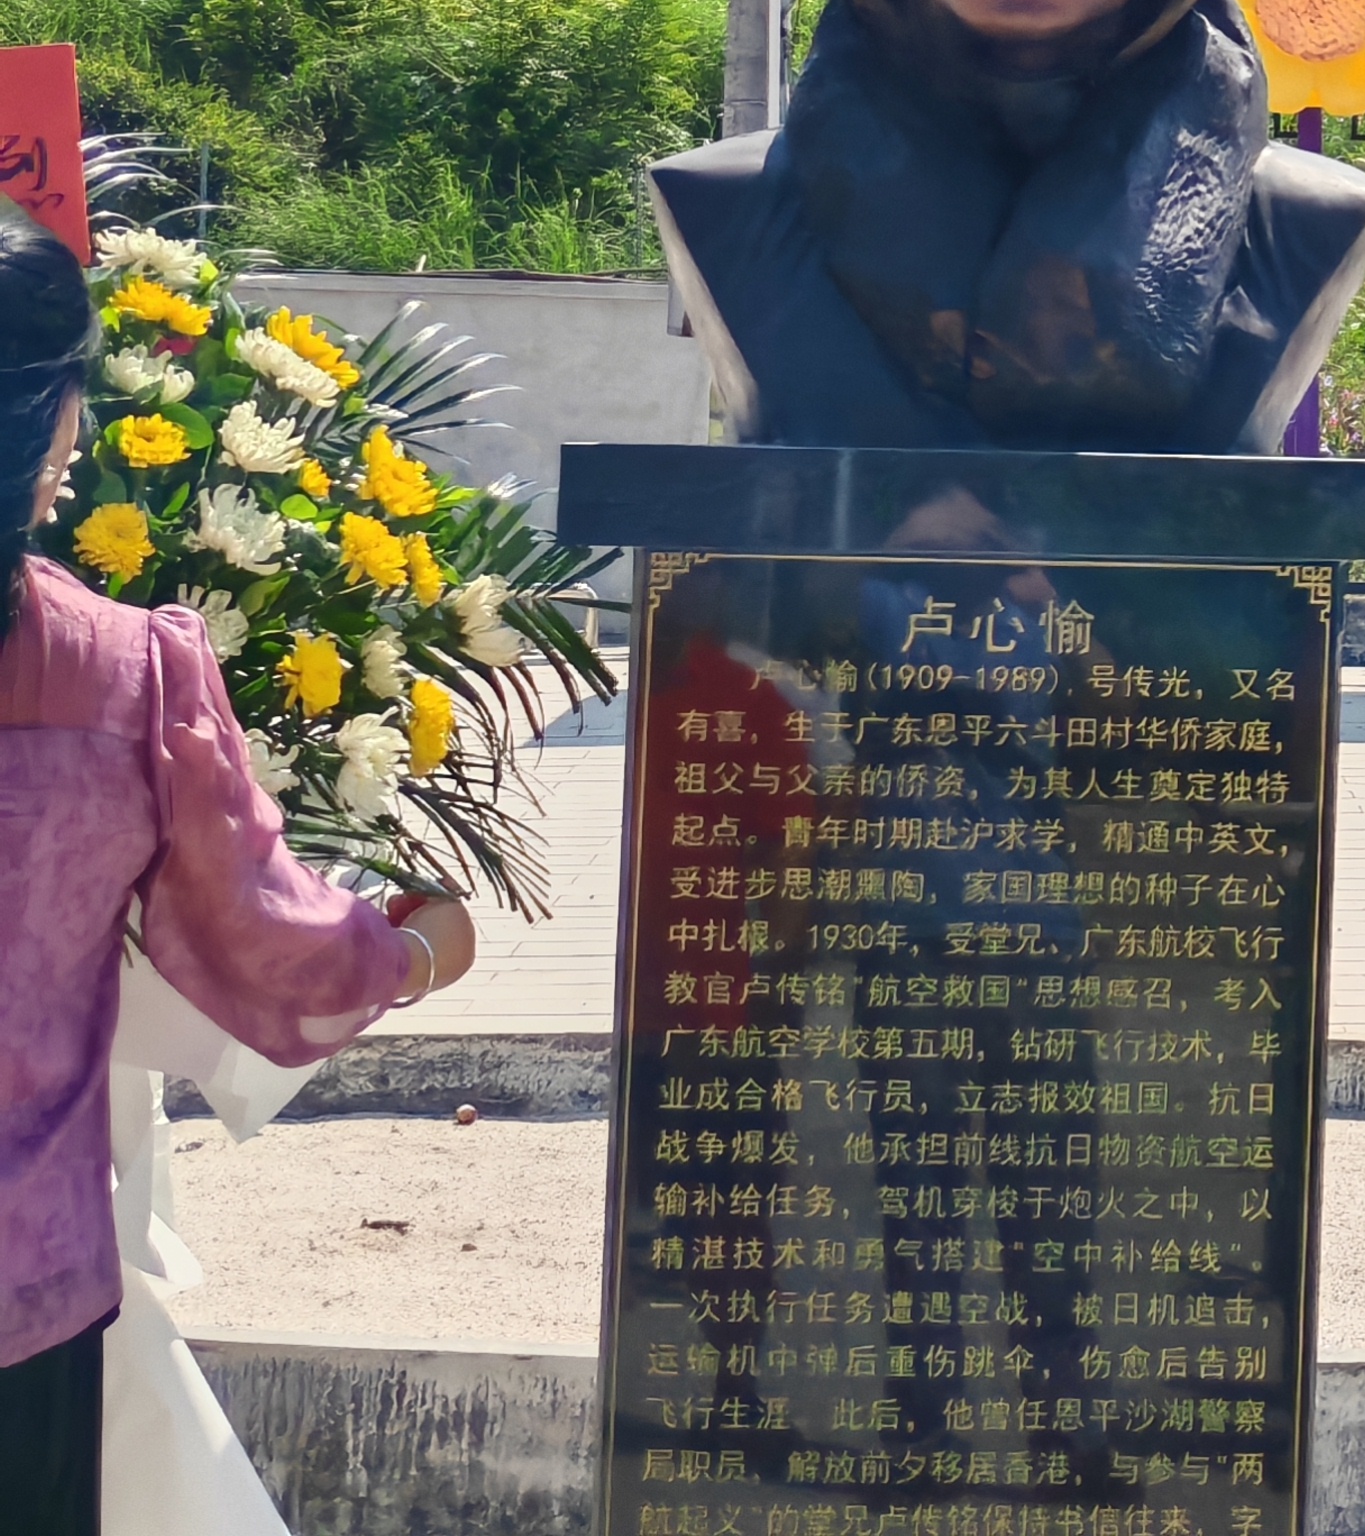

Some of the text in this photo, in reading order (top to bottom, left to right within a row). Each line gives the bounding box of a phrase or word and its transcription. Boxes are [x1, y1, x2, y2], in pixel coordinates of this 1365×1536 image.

[901, 597, 1095, 655] 卢心愉
[676, 709, 1286, 756] 有喜，生于广东恩平六斗田村华侨家庭，
[673, 761, 1290, 804] 祖父与父亲的侨资，为其人生奠定独特
[670, 812, 1288, 857] 起点。青年时期赴沪求学，精通中英文，
[668, 866, 1287, 909] 受进步思潮熏陶，家国理想的种子在心
[667, 919, 1287, 961] 中扎根。1930年，受堂兄、广东航校飞行
[660, 1026, 1282, 1066] 广东航空学校第五期，钻研飞行技术，毕
[658, 1077, 1276, 1117] 业成合格飞行员，立志报效祖国。抗日
[655, 1127, 1275, 1170] 战争爆发，他承担前线抗日物资航空运
[654, 1183, 1273, 1224] 输补给任务，驾机穿梭于炮火之中，以
[648, 1290, 1271, 1330] 一次执行任务遭遇空战，被日机追击，
[646, 1343, 1268, 1382] 运输机中弹后重伤跳伞，伤愈后告别
